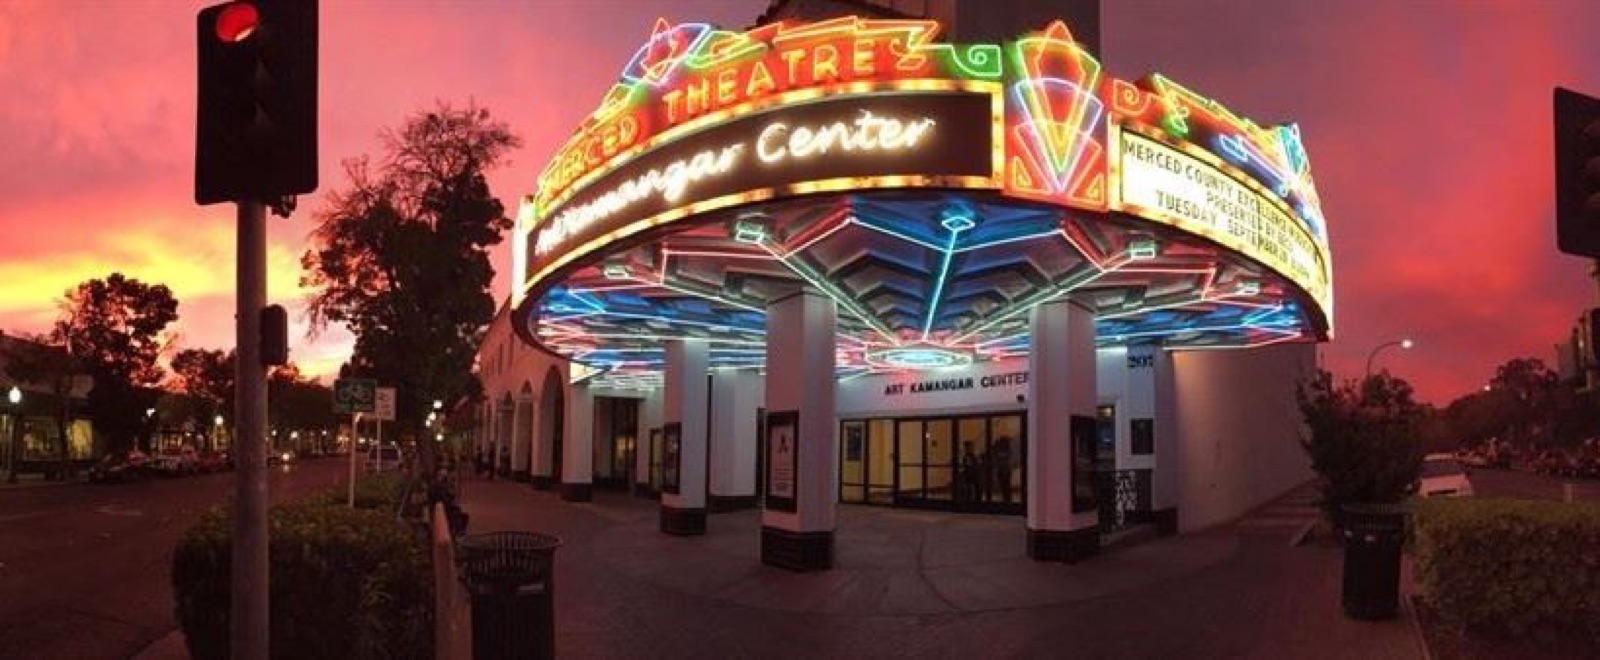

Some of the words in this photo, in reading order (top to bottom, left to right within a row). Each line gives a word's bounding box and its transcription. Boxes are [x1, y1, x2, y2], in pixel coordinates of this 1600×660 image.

[540, 114, 638, 203] MERCED
[662, 38, 876, 124] THEATRE
[756, 108, 936, 164] Center
[1122, 139, 1183, 175] MERCED
[1186, 165, 1233, 198] COUNTY
[1157, 188, 1217, 226] TUESDAY
[885, 384, 904, 395] ART
[910, 376, 974, 394] KAMANGAR
